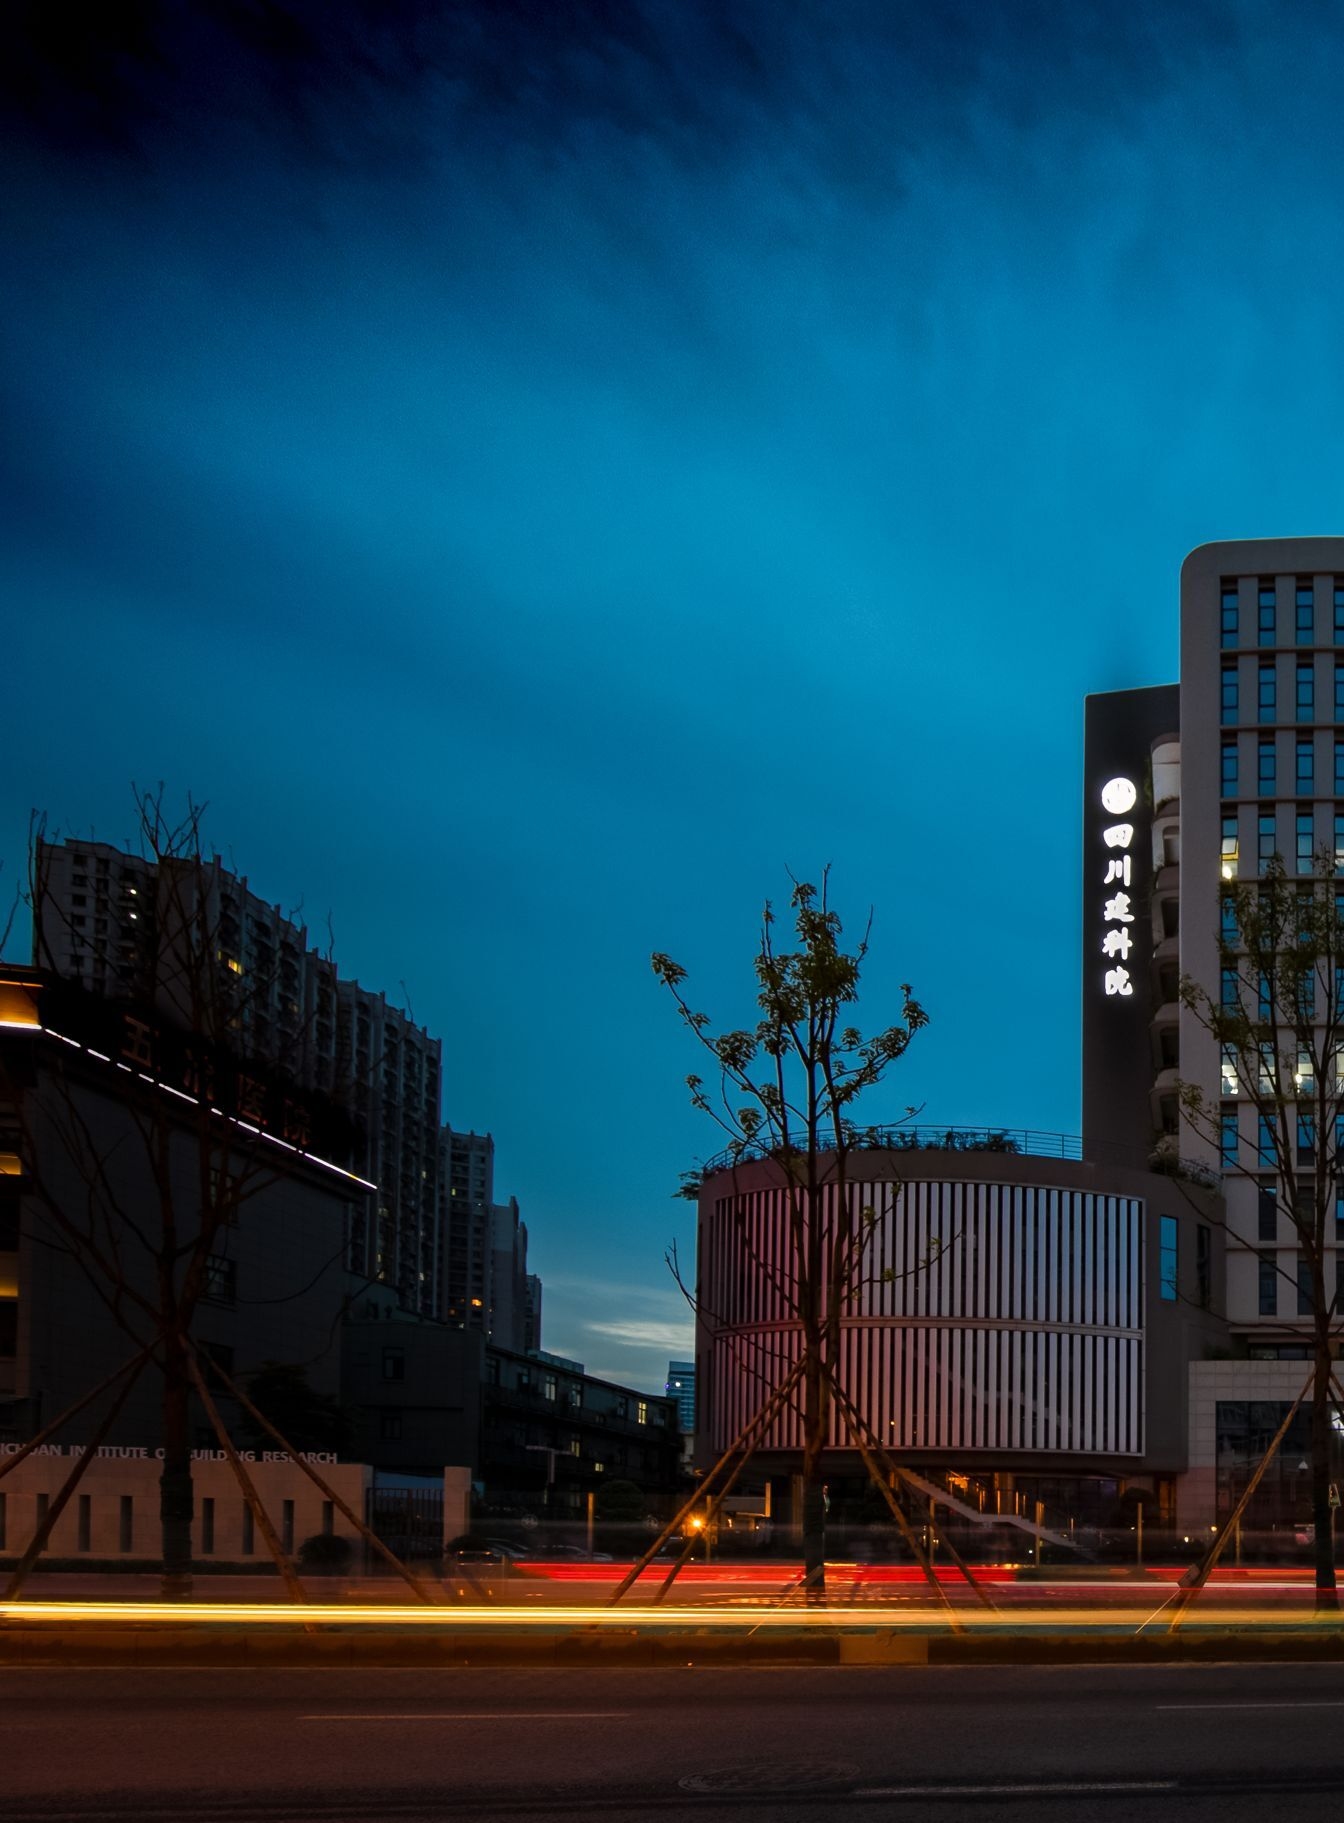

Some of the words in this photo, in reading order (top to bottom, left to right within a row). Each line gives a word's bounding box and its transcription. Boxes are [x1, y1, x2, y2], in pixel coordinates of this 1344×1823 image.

[1102, 823, 1135, 996] 四川建科院
[0, 1442, 62, 1456] ICHAN
[69, 1444, 148, 1459] INTITUTE
[190, 1448, 256, 1462] UILDNG
